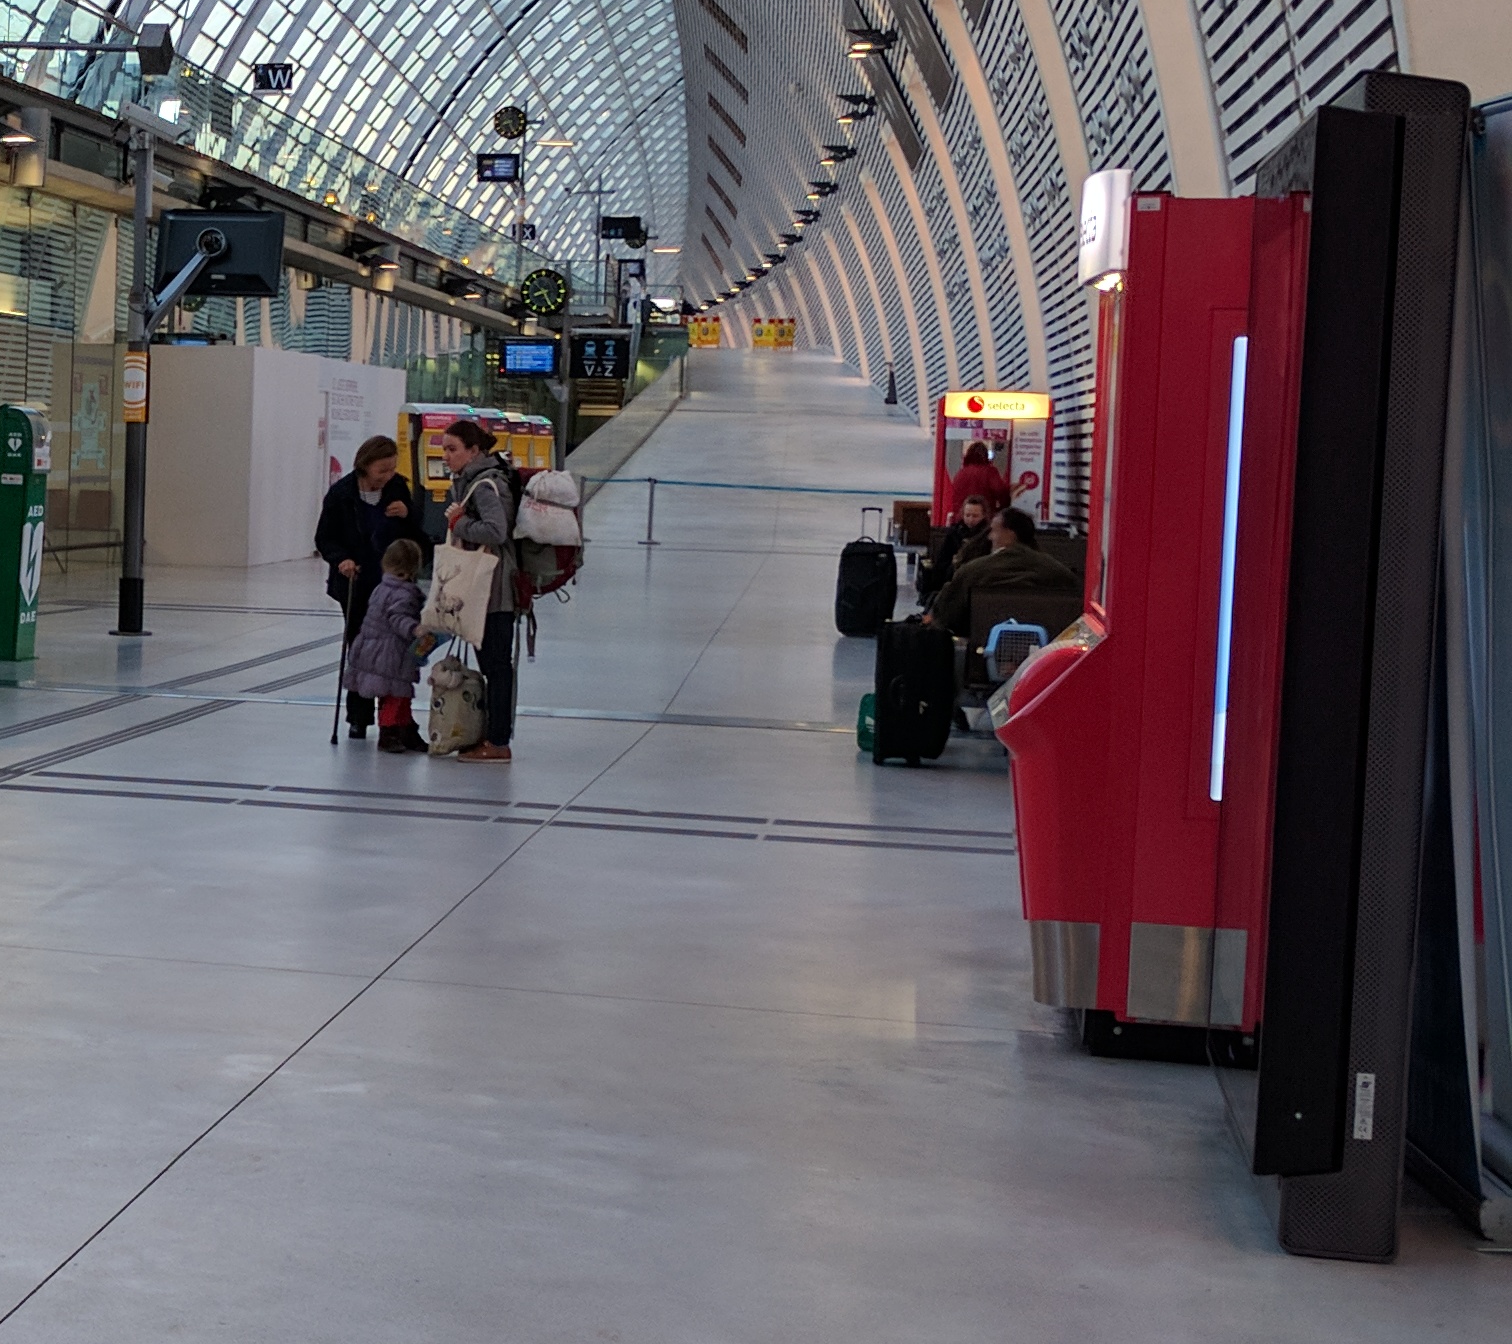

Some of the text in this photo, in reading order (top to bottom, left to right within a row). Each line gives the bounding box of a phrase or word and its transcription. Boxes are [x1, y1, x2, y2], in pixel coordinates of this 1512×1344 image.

[268, 69, 291, 89] W
[584, 365, 595, 376] V
[604, 365, 614, 376] Z
[988, 402, 1025, 411] selecta
[28, 506, 44, 517] AED
[20, 611, 36, 624] DAE
